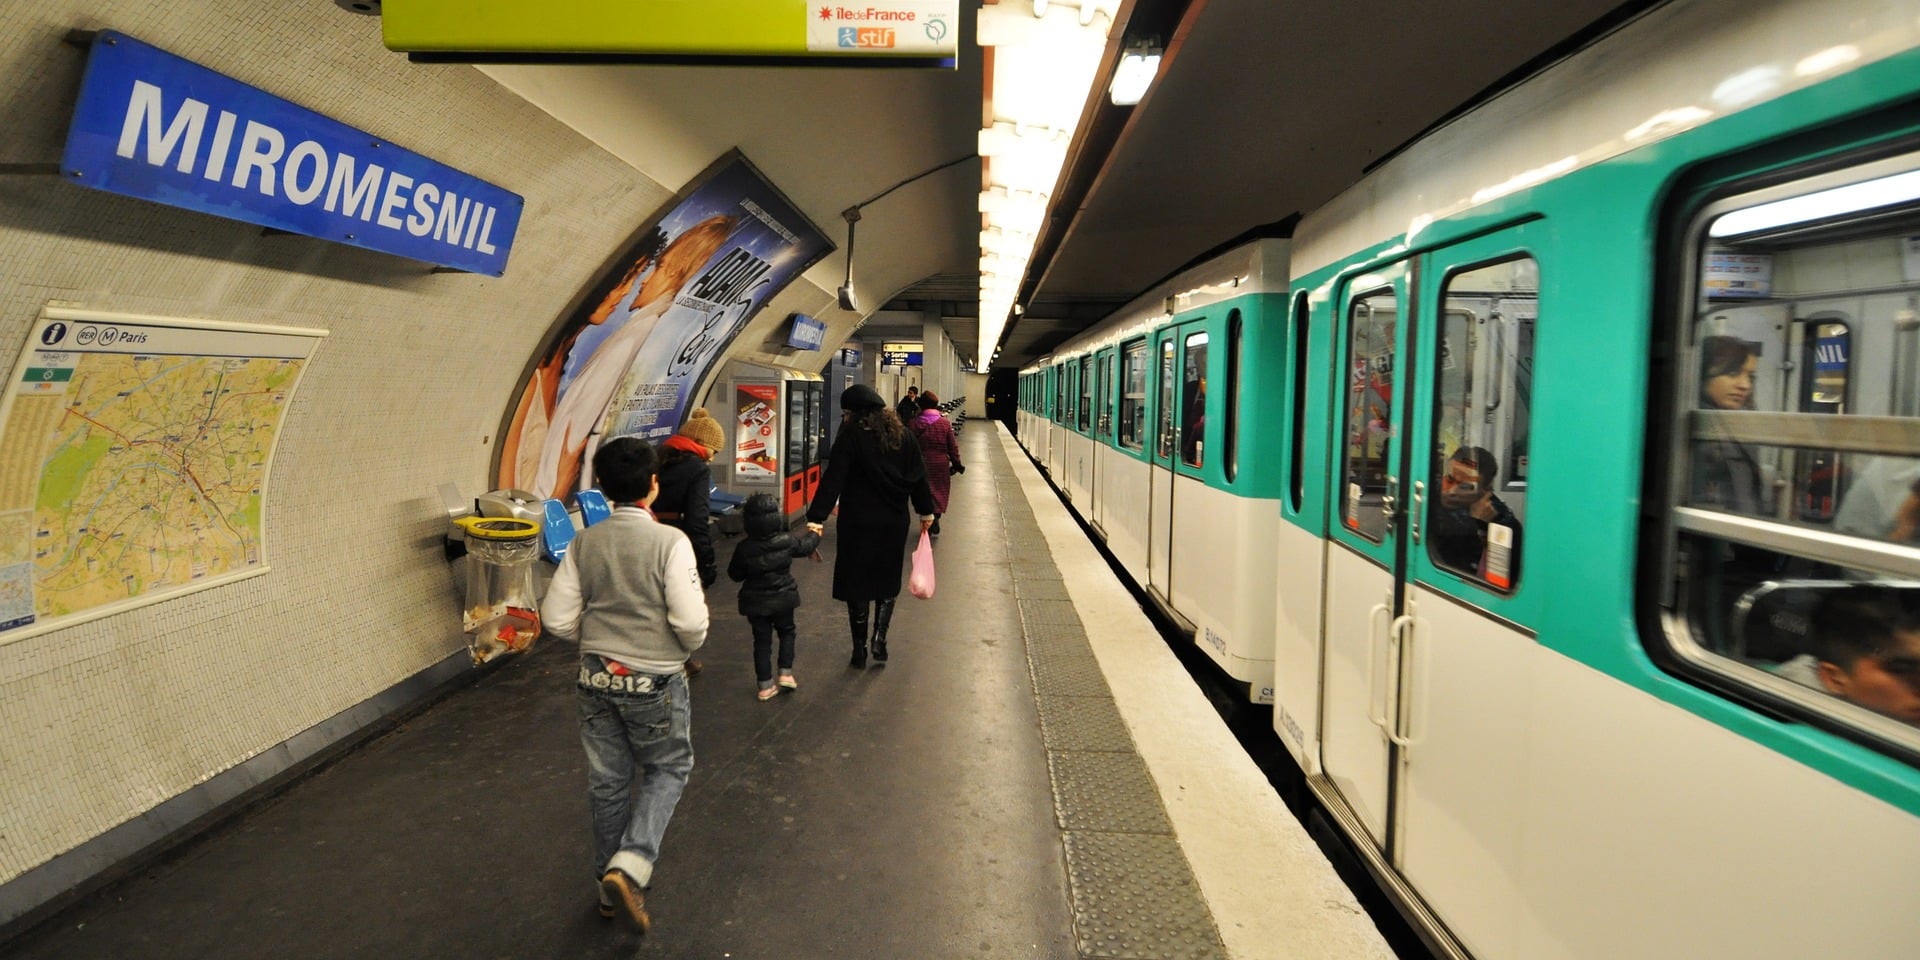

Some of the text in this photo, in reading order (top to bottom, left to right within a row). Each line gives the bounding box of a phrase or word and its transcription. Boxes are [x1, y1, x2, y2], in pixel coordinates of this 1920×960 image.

[116, 80, 497, 255] MIROMESNIL
[687, 247, 772, 307] ADAM
[80, 331, 94, 339] RER
[119, 331, 148, 344] Paris
